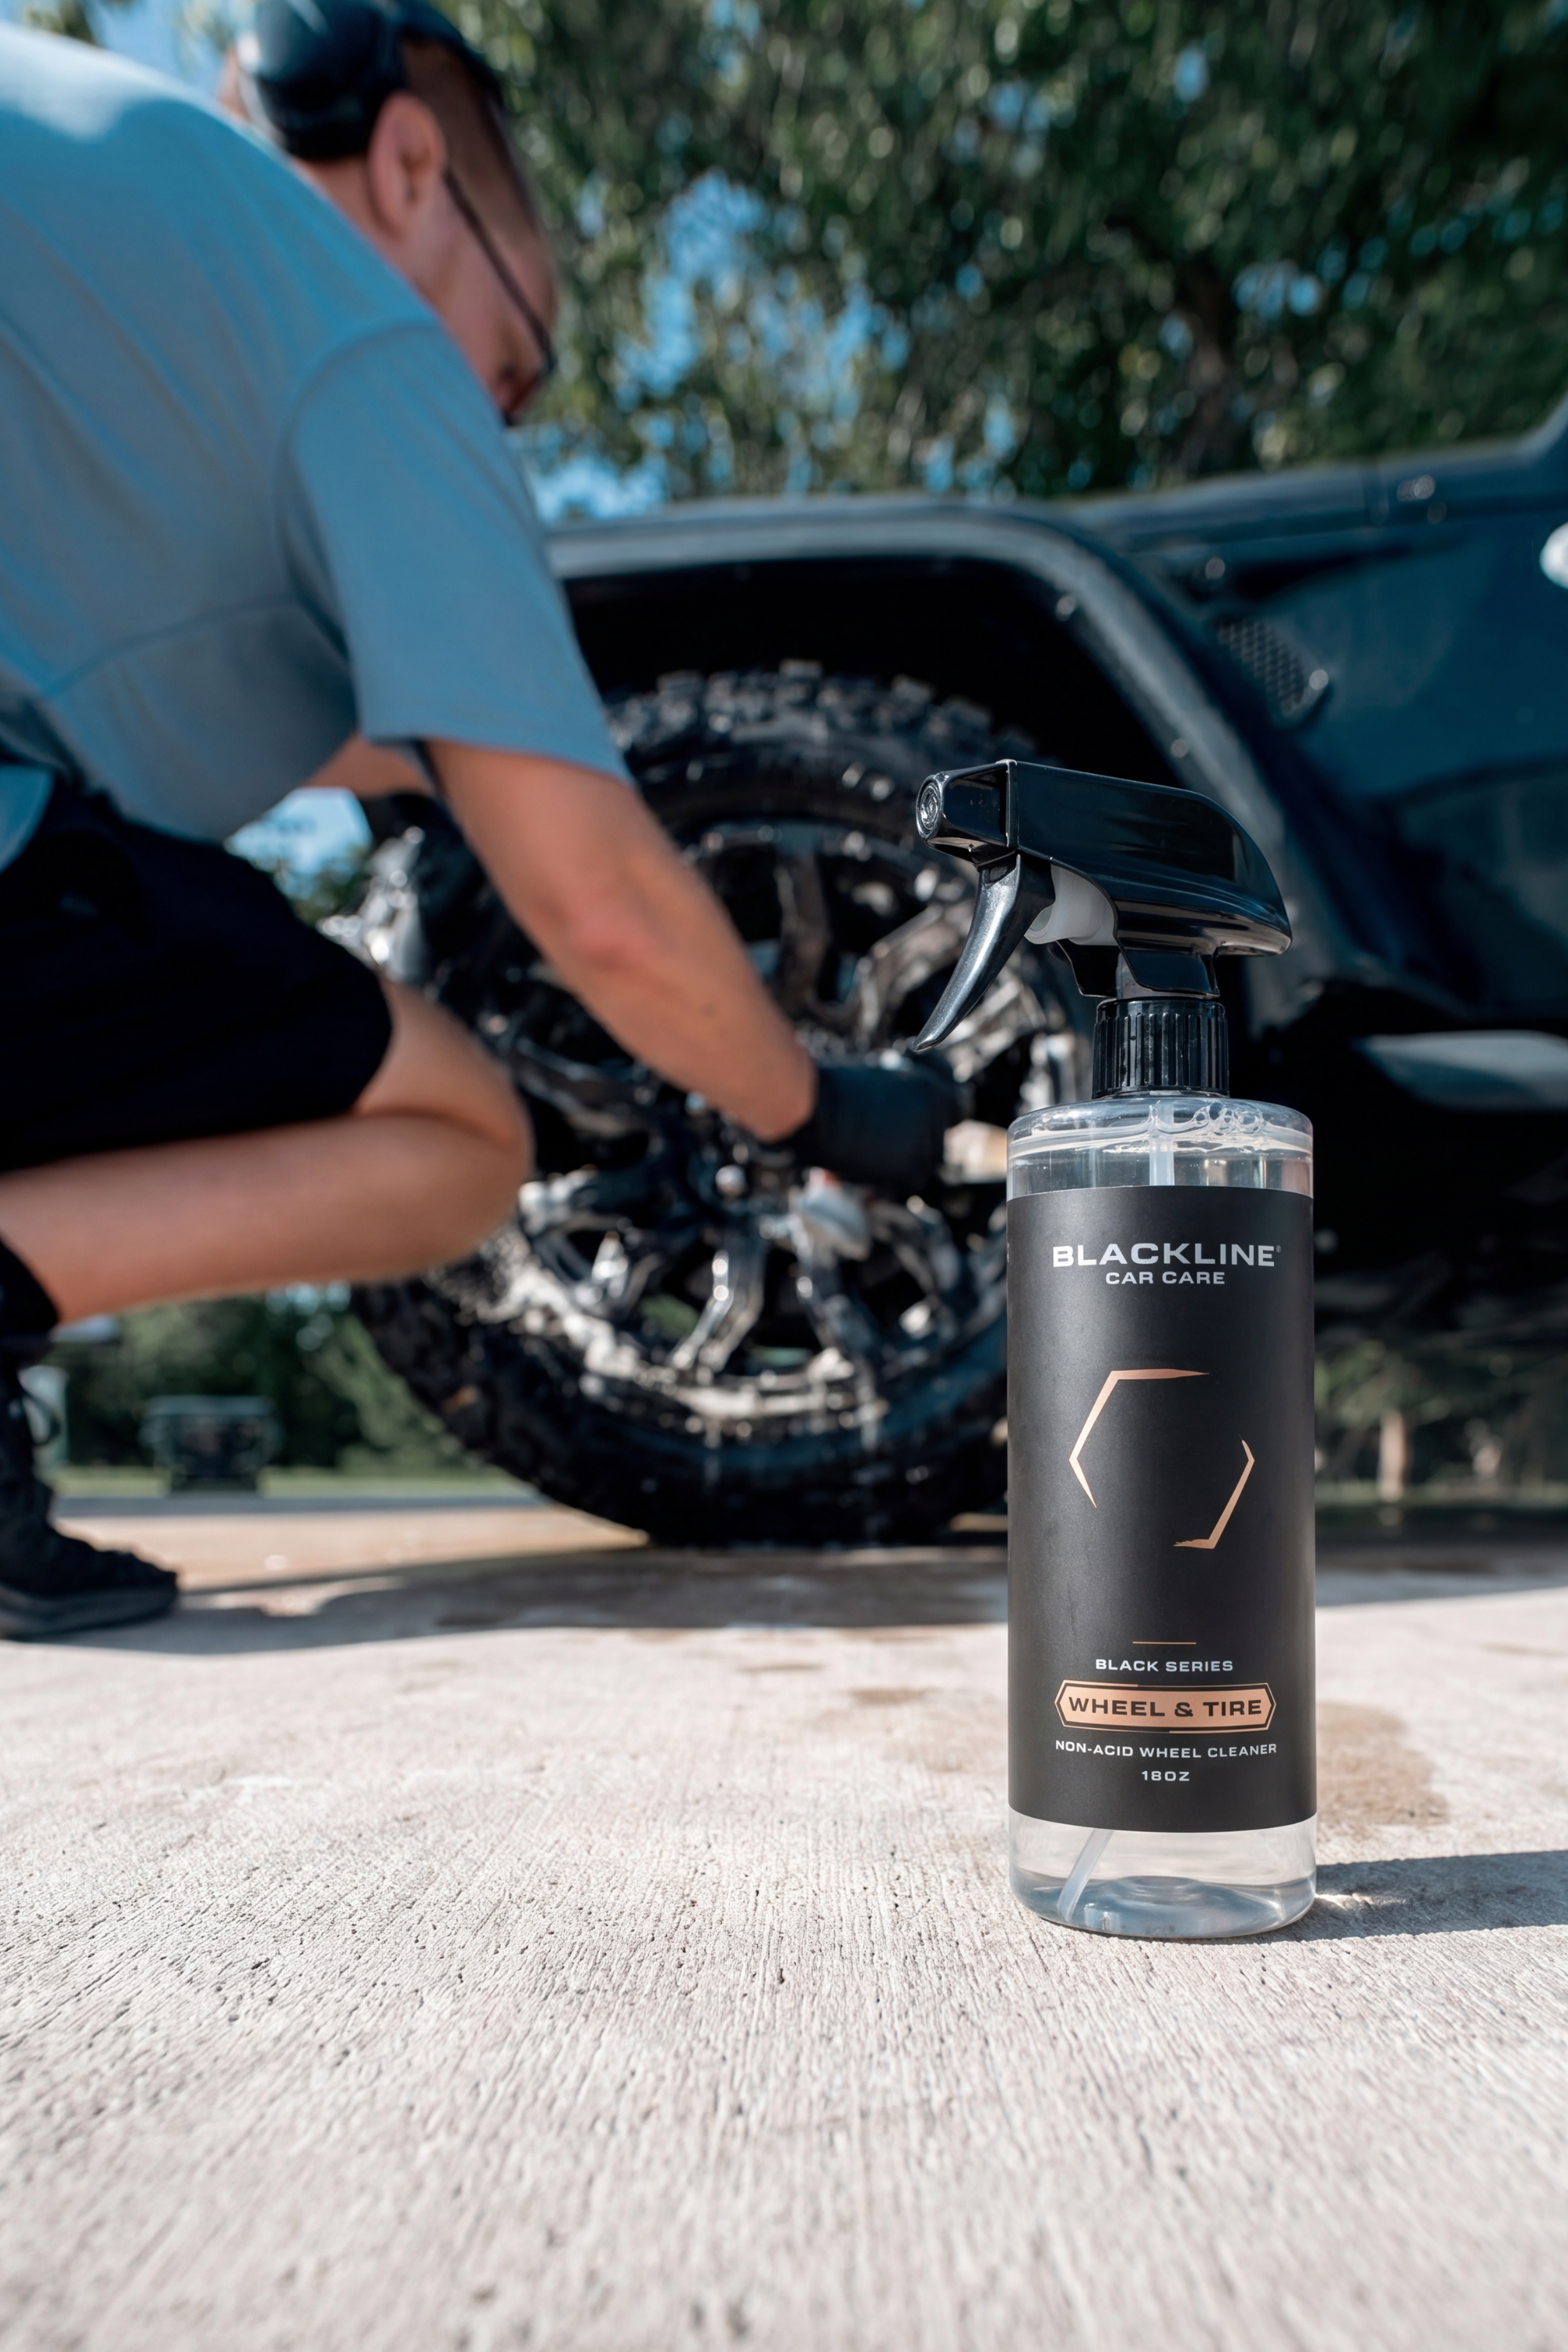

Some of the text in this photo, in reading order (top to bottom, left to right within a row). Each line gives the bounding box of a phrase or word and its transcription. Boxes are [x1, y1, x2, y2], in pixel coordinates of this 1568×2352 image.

[1105, 1271, 1225, 1285] CAR CARE
[1095, 1659, 1233, 1672] BLACK SERIES
[1069, 1697, 1262, 1717] WHEEL & TIRE
[1055, 1740, 1277, 1758] NON-ACID WHEEL CLEANER
[1142, 1770, 1190, 1781] 18OZ
